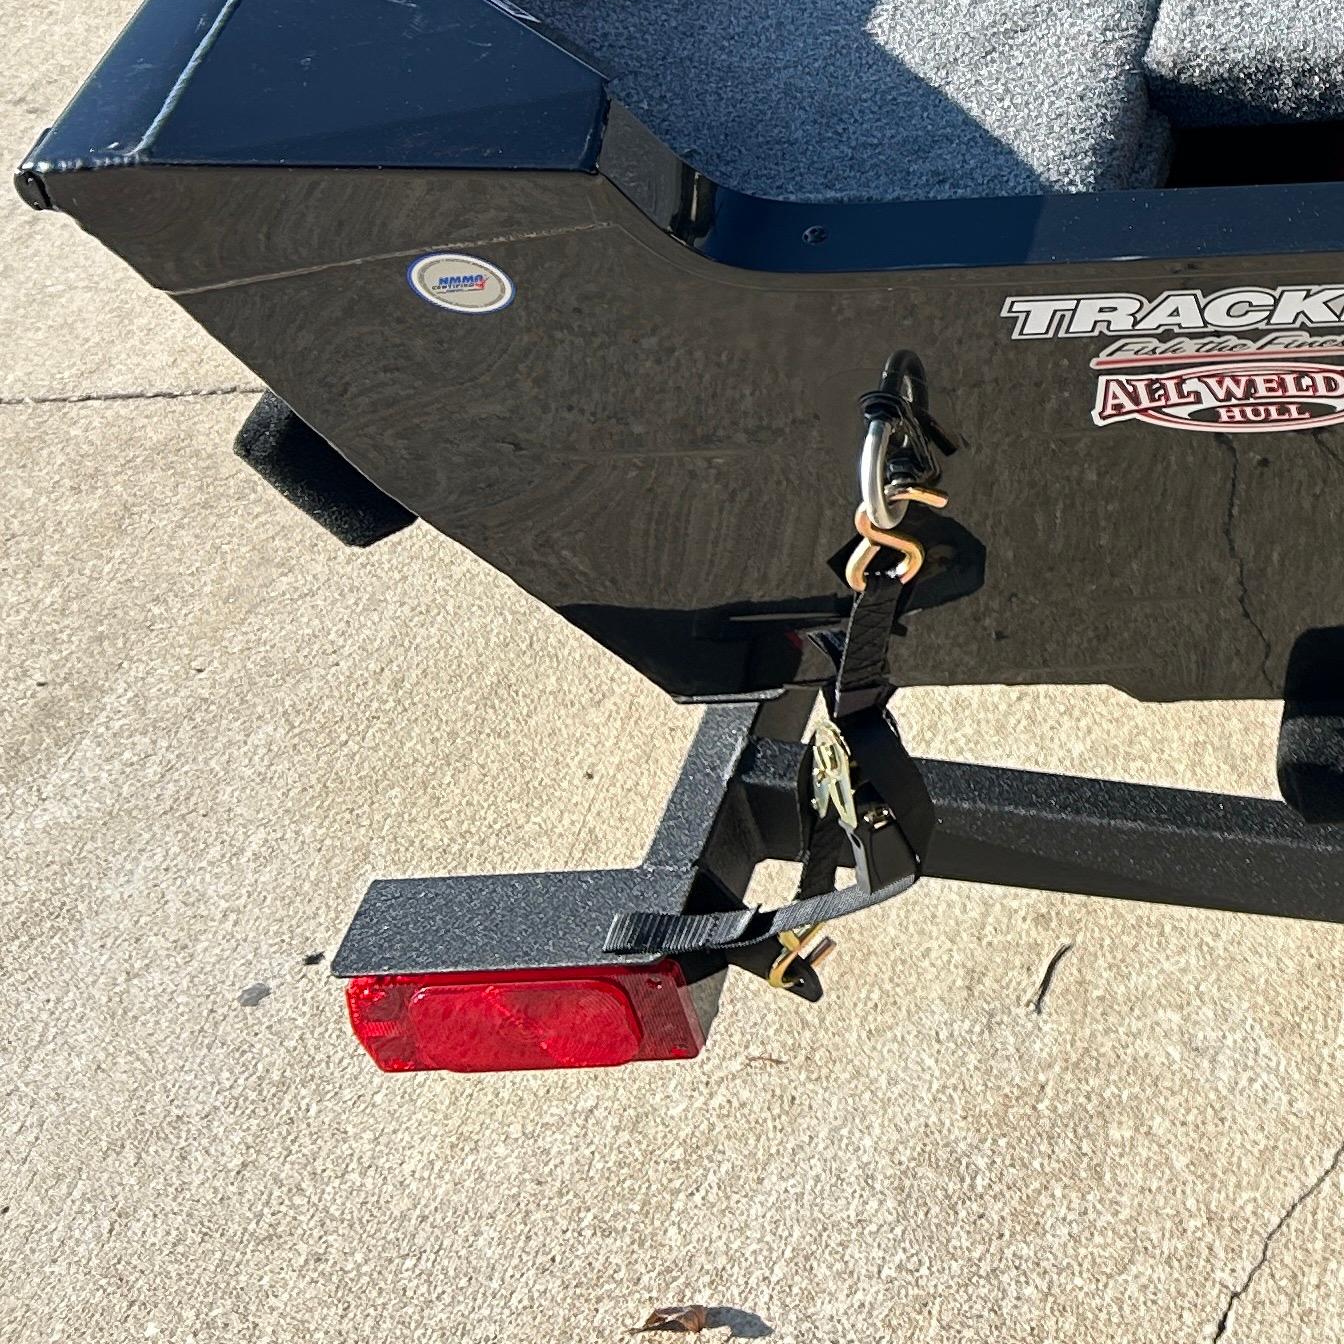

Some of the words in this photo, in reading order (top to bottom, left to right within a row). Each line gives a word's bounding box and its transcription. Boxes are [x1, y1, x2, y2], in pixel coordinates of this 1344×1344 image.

[1194, 336, 1249, 354] the
[1101, 377, 1200, 418] ALL
[1216, 404, 1312, 423] HULL
